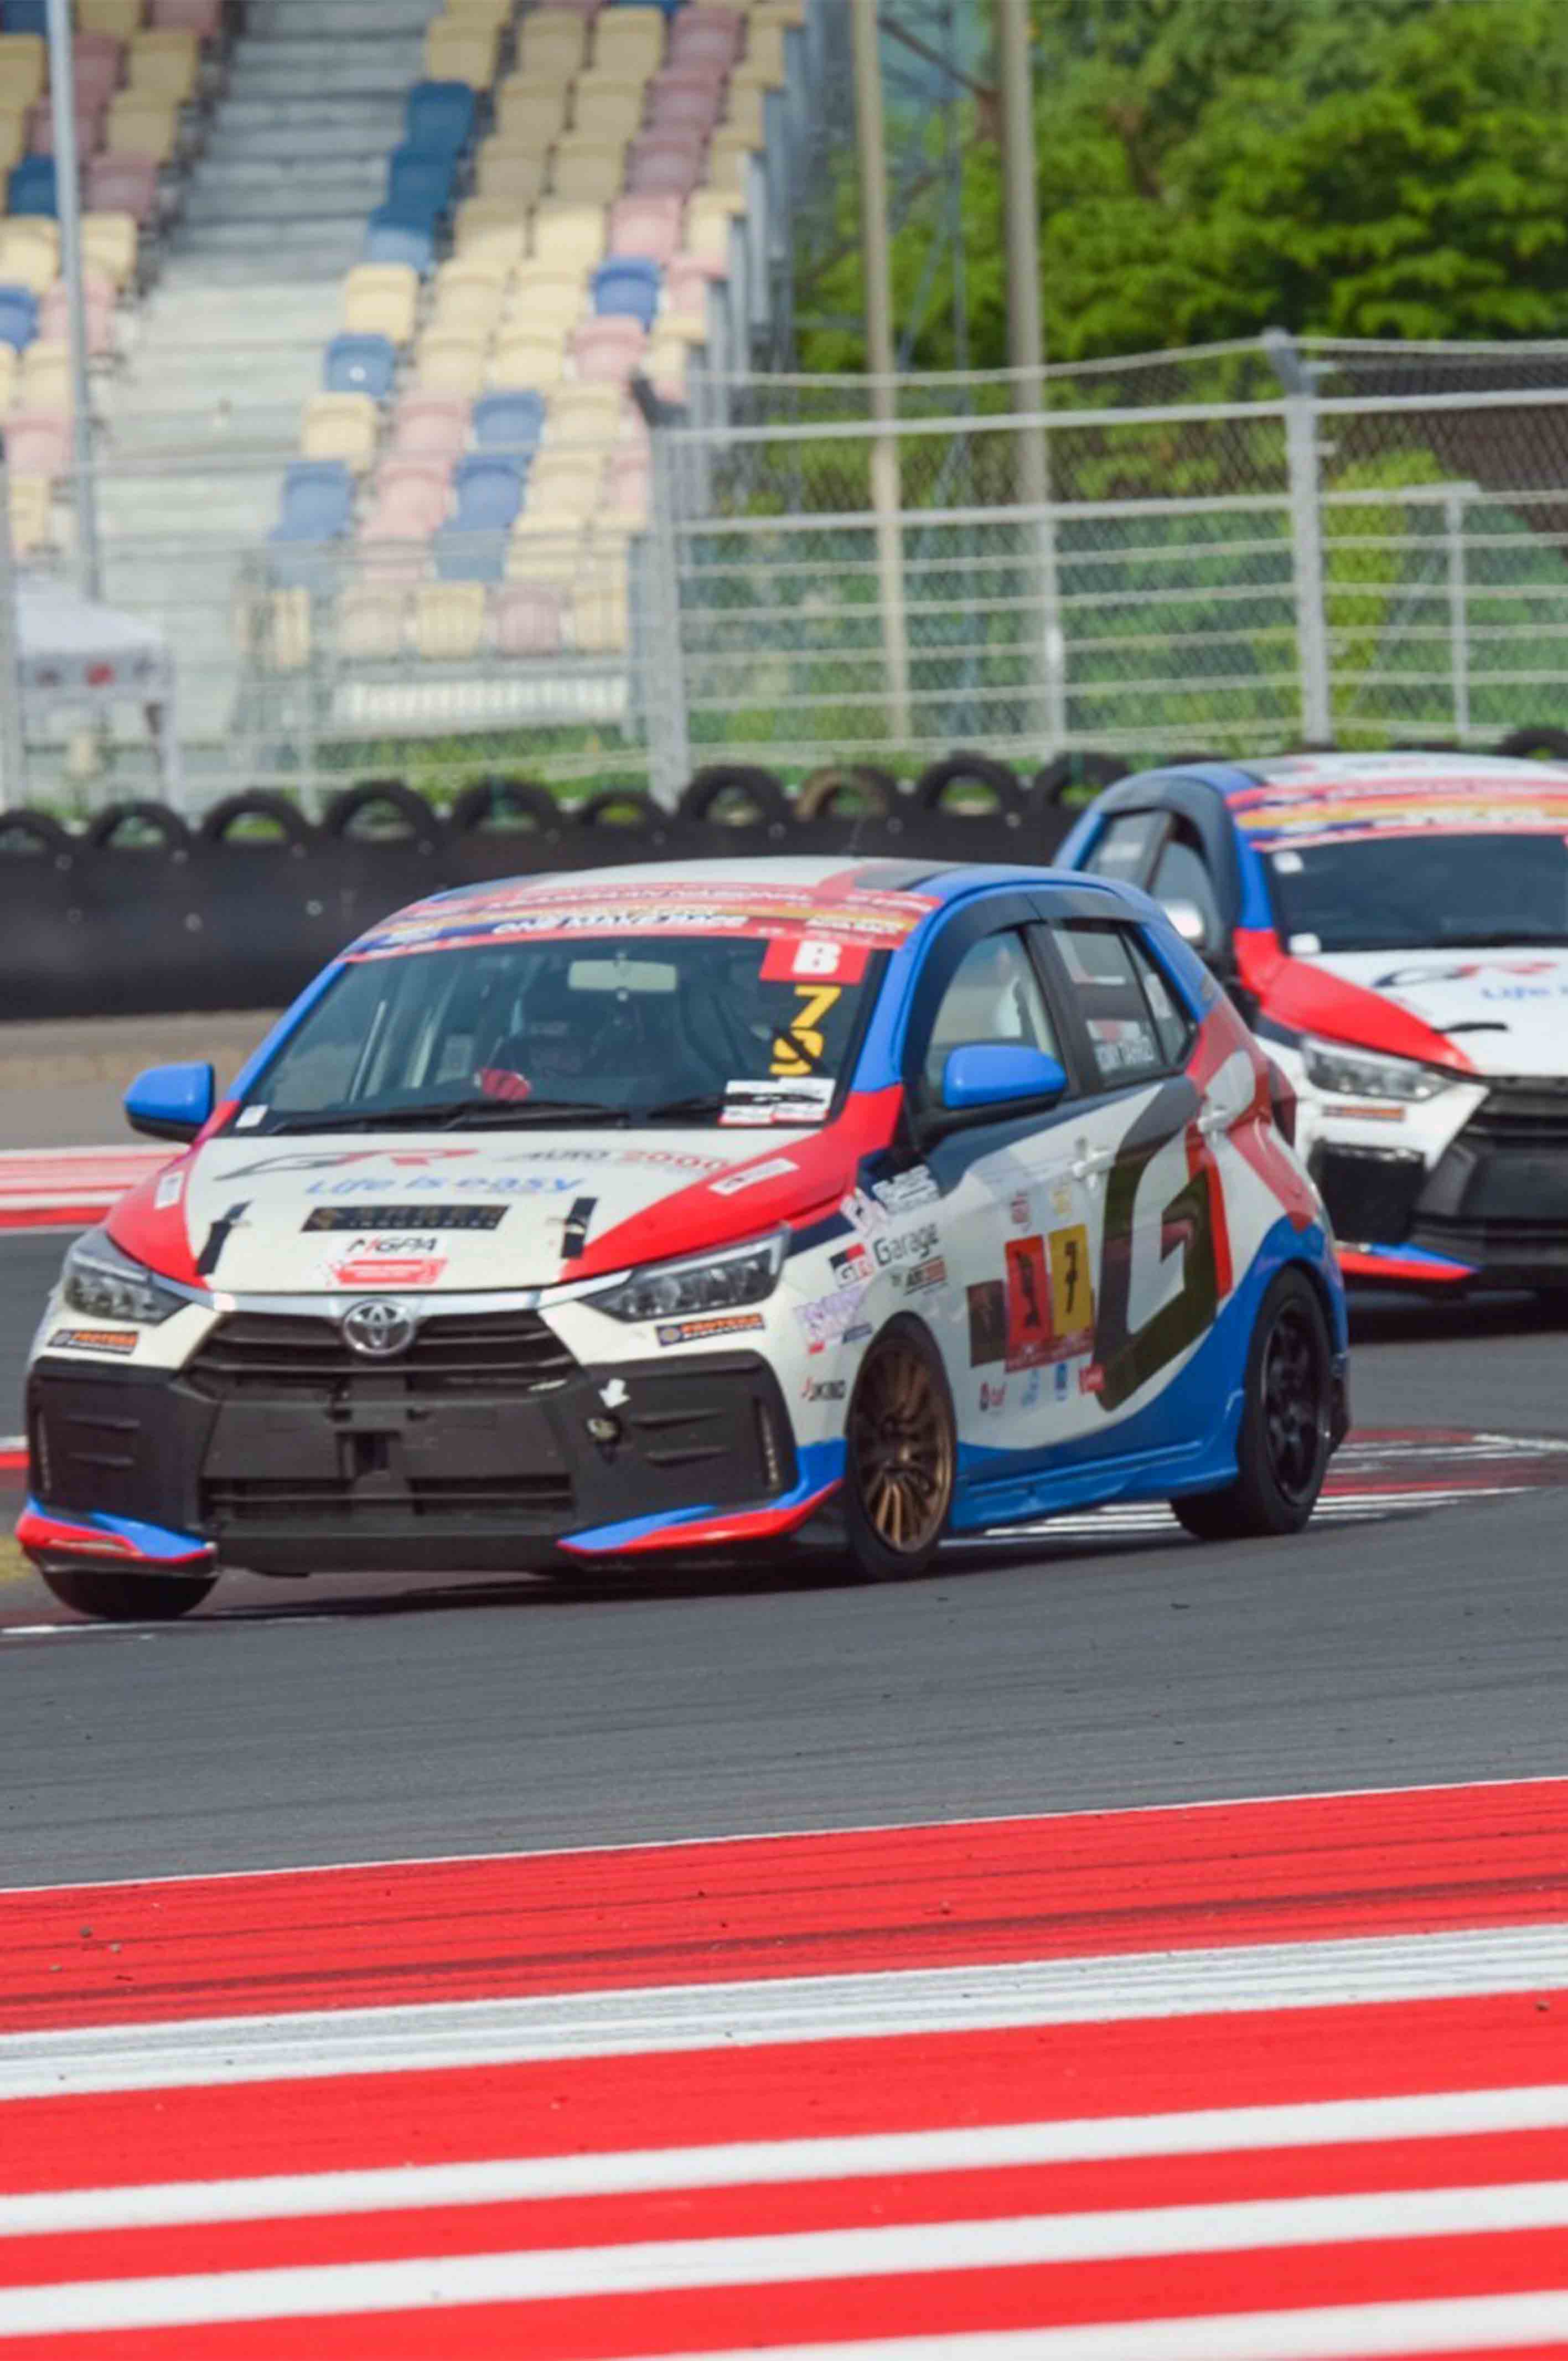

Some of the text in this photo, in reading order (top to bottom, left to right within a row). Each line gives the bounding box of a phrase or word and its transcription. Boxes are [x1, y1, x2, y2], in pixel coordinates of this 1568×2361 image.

[793, 940, 842, 974] B
[790, 985, 841, 1028] 7
[873, 1224, 939, 1267] Garage
